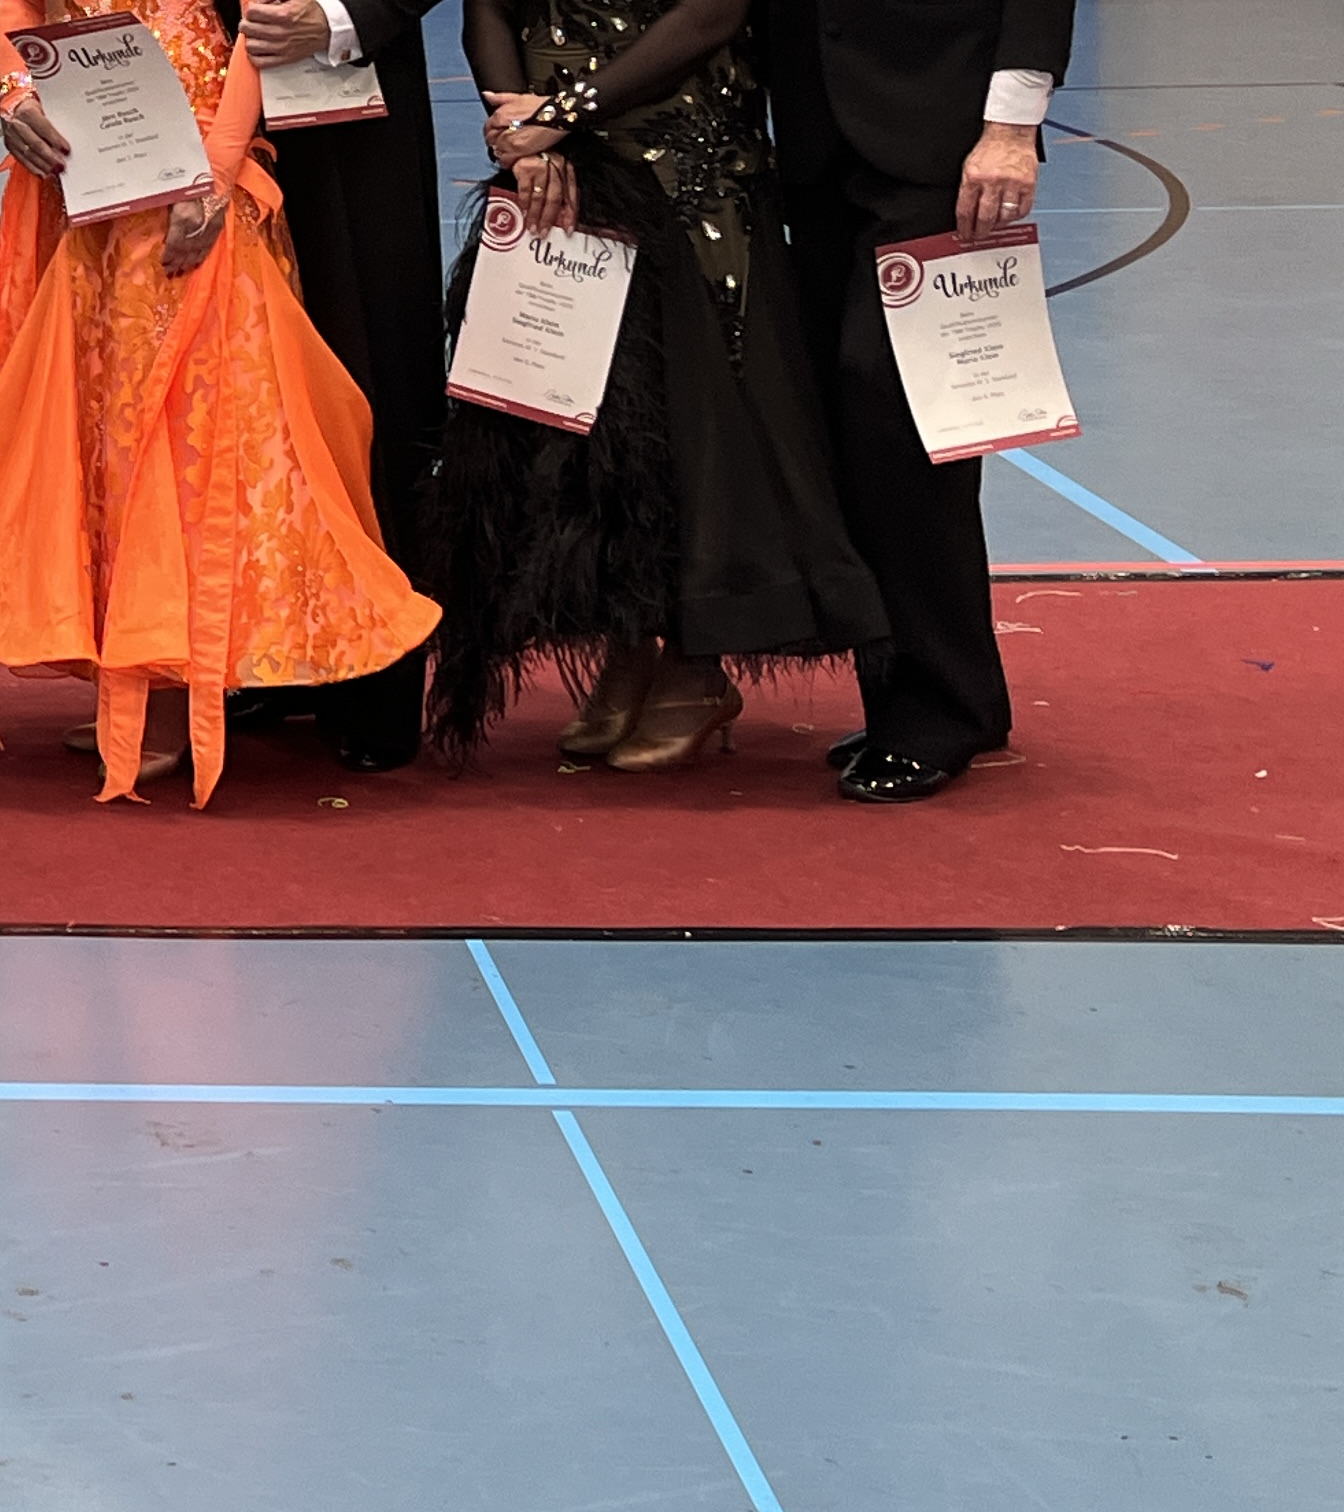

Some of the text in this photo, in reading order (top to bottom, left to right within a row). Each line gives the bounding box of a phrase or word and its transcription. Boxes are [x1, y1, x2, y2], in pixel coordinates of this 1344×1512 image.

[68, 33, 143, 70] Urkunde
[529, 238, 612, 283] Urkunde
[933, 255, 1020, 302] Urkunde
